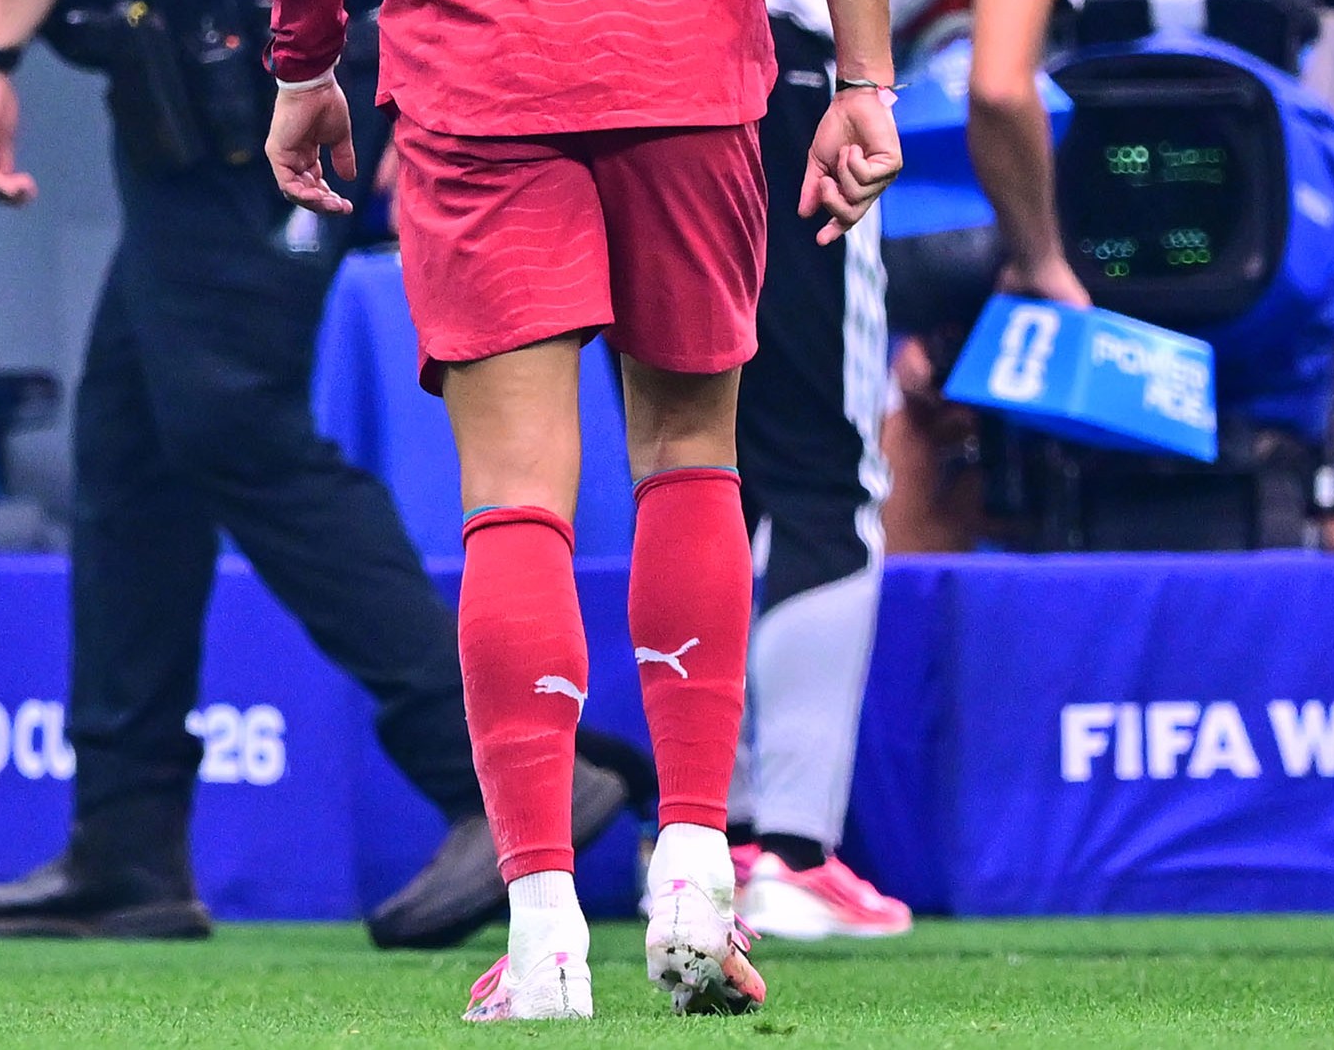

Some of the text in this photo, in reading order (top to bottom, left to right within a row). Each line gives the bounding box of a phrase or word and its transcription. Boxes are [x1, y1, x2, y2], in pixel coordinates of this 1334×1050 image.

[13, 698, 77, 781] CU
[185, 702, 287, 787] 26
[1059, 700, 1262, 783] FIFA
